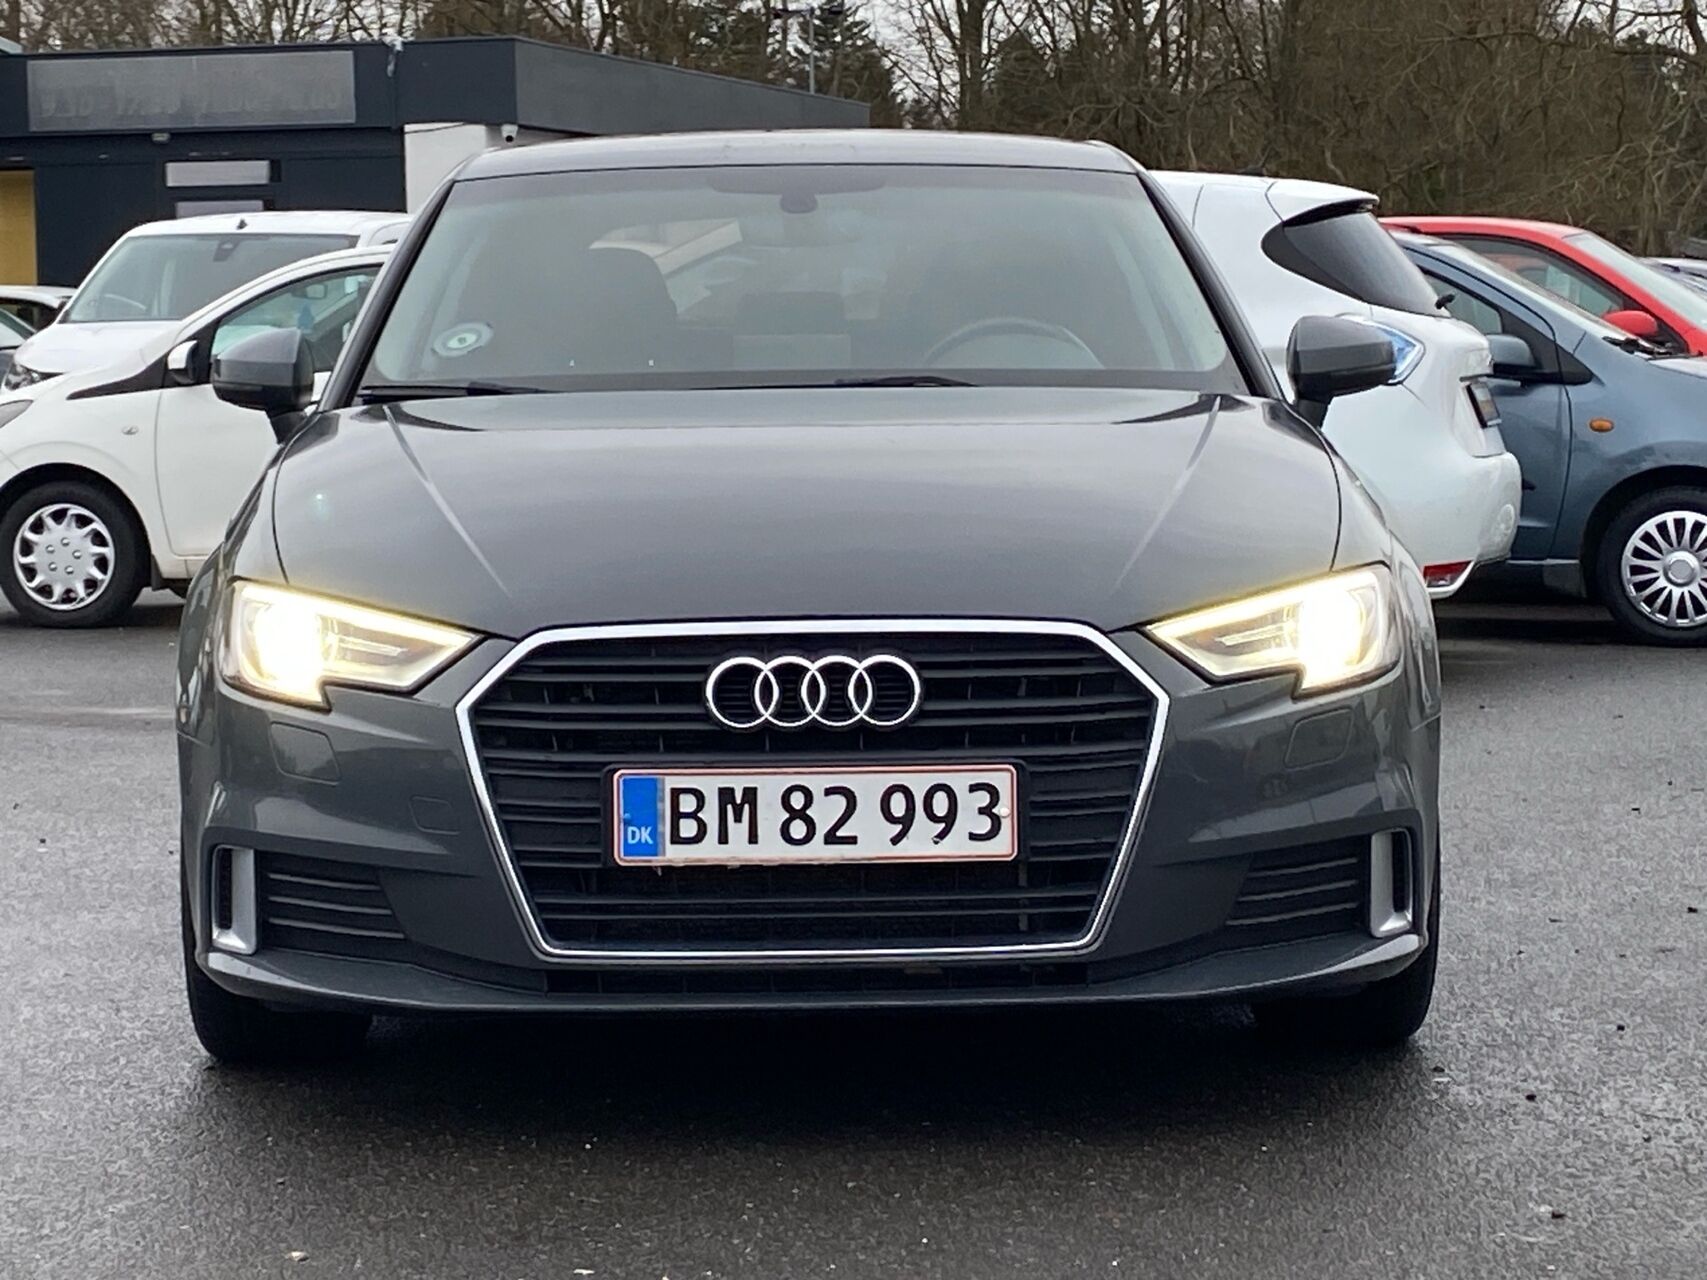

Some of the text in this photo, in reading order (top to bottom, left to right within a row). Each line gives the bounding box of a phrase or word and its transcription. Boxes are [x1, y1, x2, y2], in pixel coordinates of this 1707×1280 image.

[669, 782, 1001, 846] BM 82 993
[627, 826, 654, 844] DK
